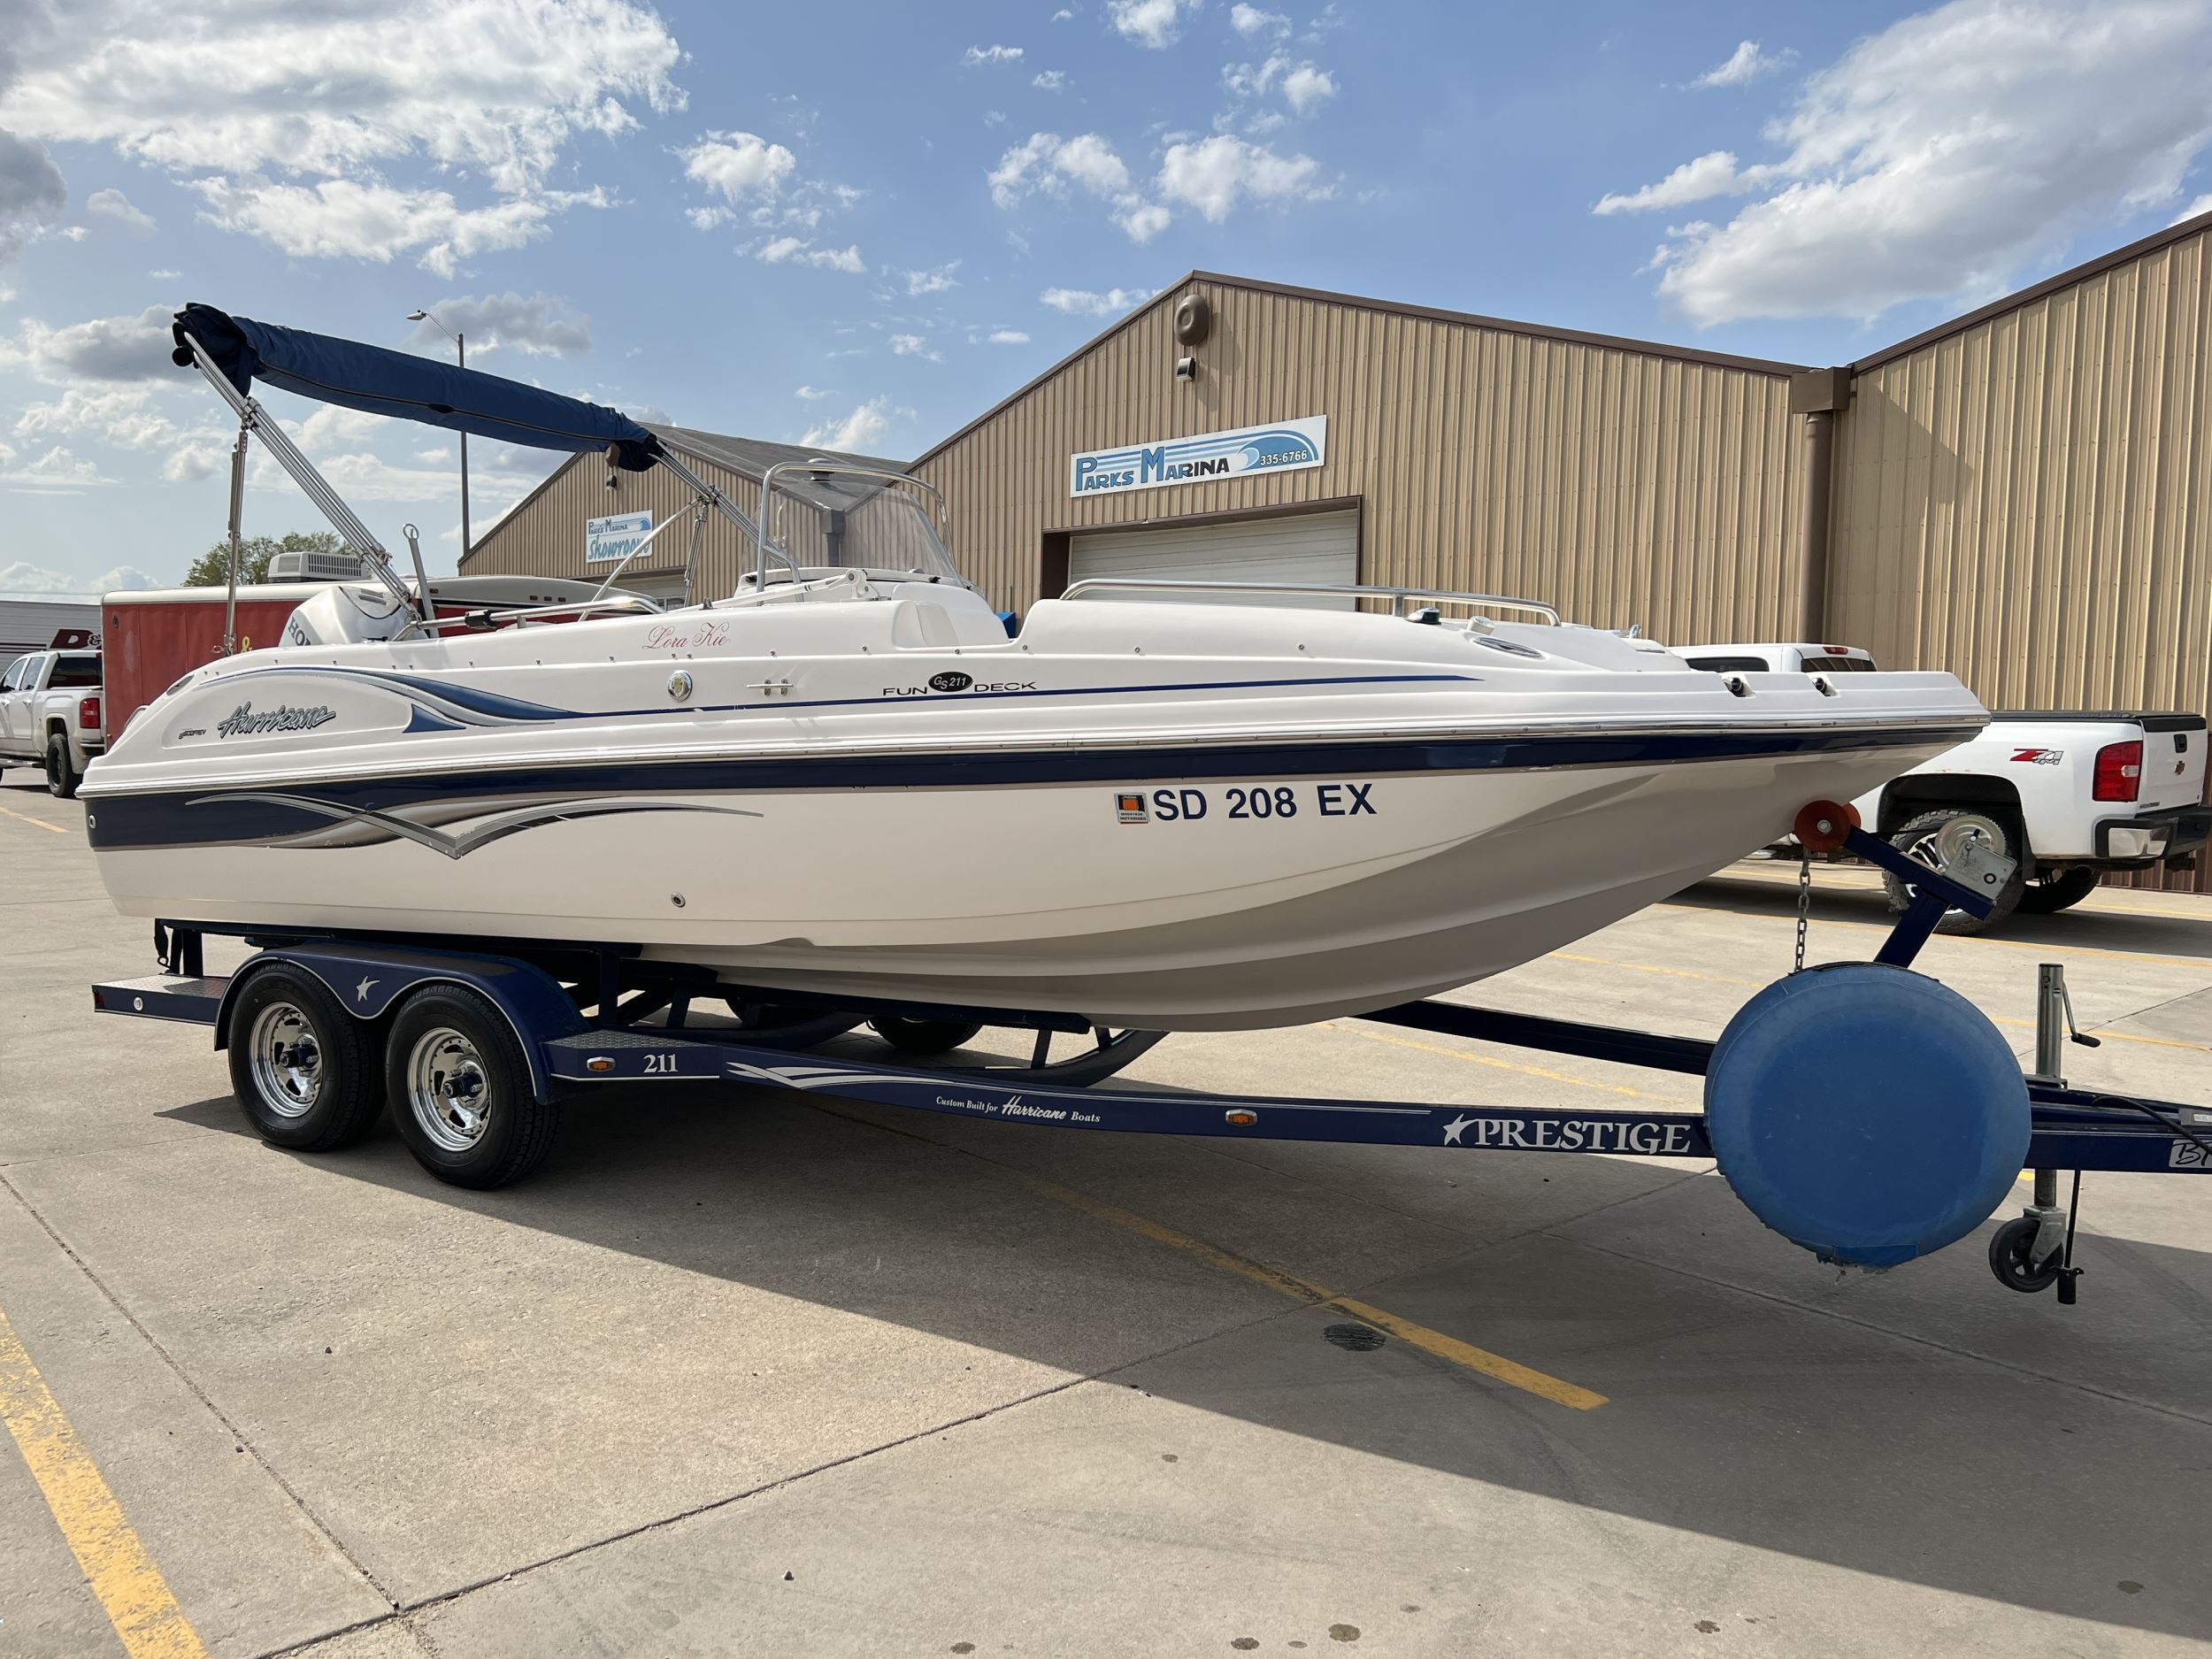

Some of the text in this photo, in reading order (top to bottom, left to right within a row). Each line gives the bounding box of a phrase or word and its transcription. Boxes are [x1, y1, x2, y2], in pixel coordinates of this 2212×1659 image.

[1075, 446, 1308, 491] PARKS MARINA 335-6766
[642, 625, 687, 649] Lora
[883, 687, 927, 695] FUN
[974, 682, 1037, 692] DECK
[218, 702, 336, 738] Hurricane
[1153, 783, 1378, 821] SD 208 EX
[643, 1054, 679, 1073] 211
[936, 1094, 1101, 1123] Custom Built for Hurricane Boats
[1475, 1118, 1691, 1155] PRESTIGE
